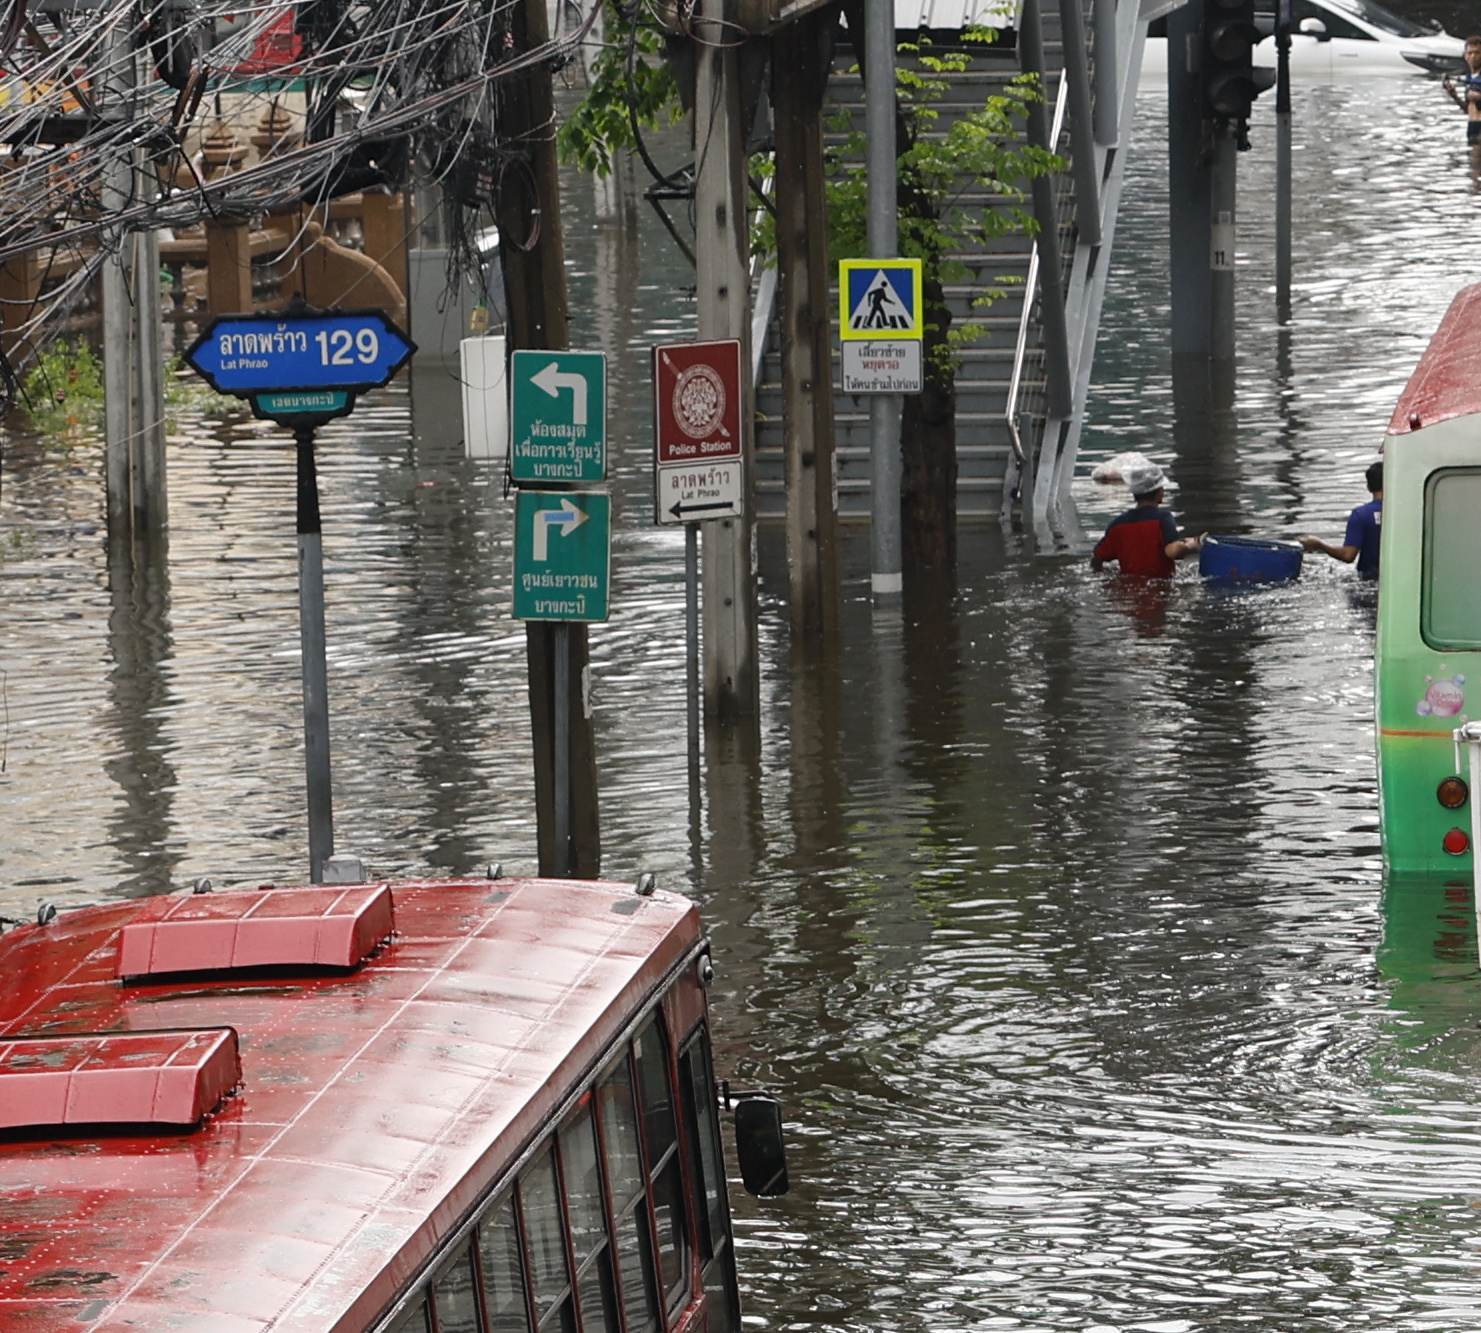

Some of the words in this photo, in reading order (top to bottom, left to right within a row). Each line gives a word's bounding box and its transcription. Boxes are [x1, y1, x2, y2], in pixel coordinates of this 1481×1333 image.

[220, 324, 307, 355] ลาดพร้าว
[315, 328, 379, 366] 129
[221, 359, 237, 370] Lat
[239, 358, 268, 369] Phrao
[531, 419, 586, 441] ห้องสมุด
[515, 436, 601, 463] เพื่อการเรียนรู้
[669, 444, 696, 456] Police
[700, 441, 731, 453] Station
[534, 460, 582, 477] บางกะปิ
[672, 468, 730, 489] ลาดพร้าว
[682, 491, 693, 500] Lat
[697, 490, 720, 498] Phrao
[522, 569, 598, 591] ศูนย์เยาวชน
[535, 594, 585, 614] บางกะปิ
[1430, 691, 1462, 700] Vitamin
